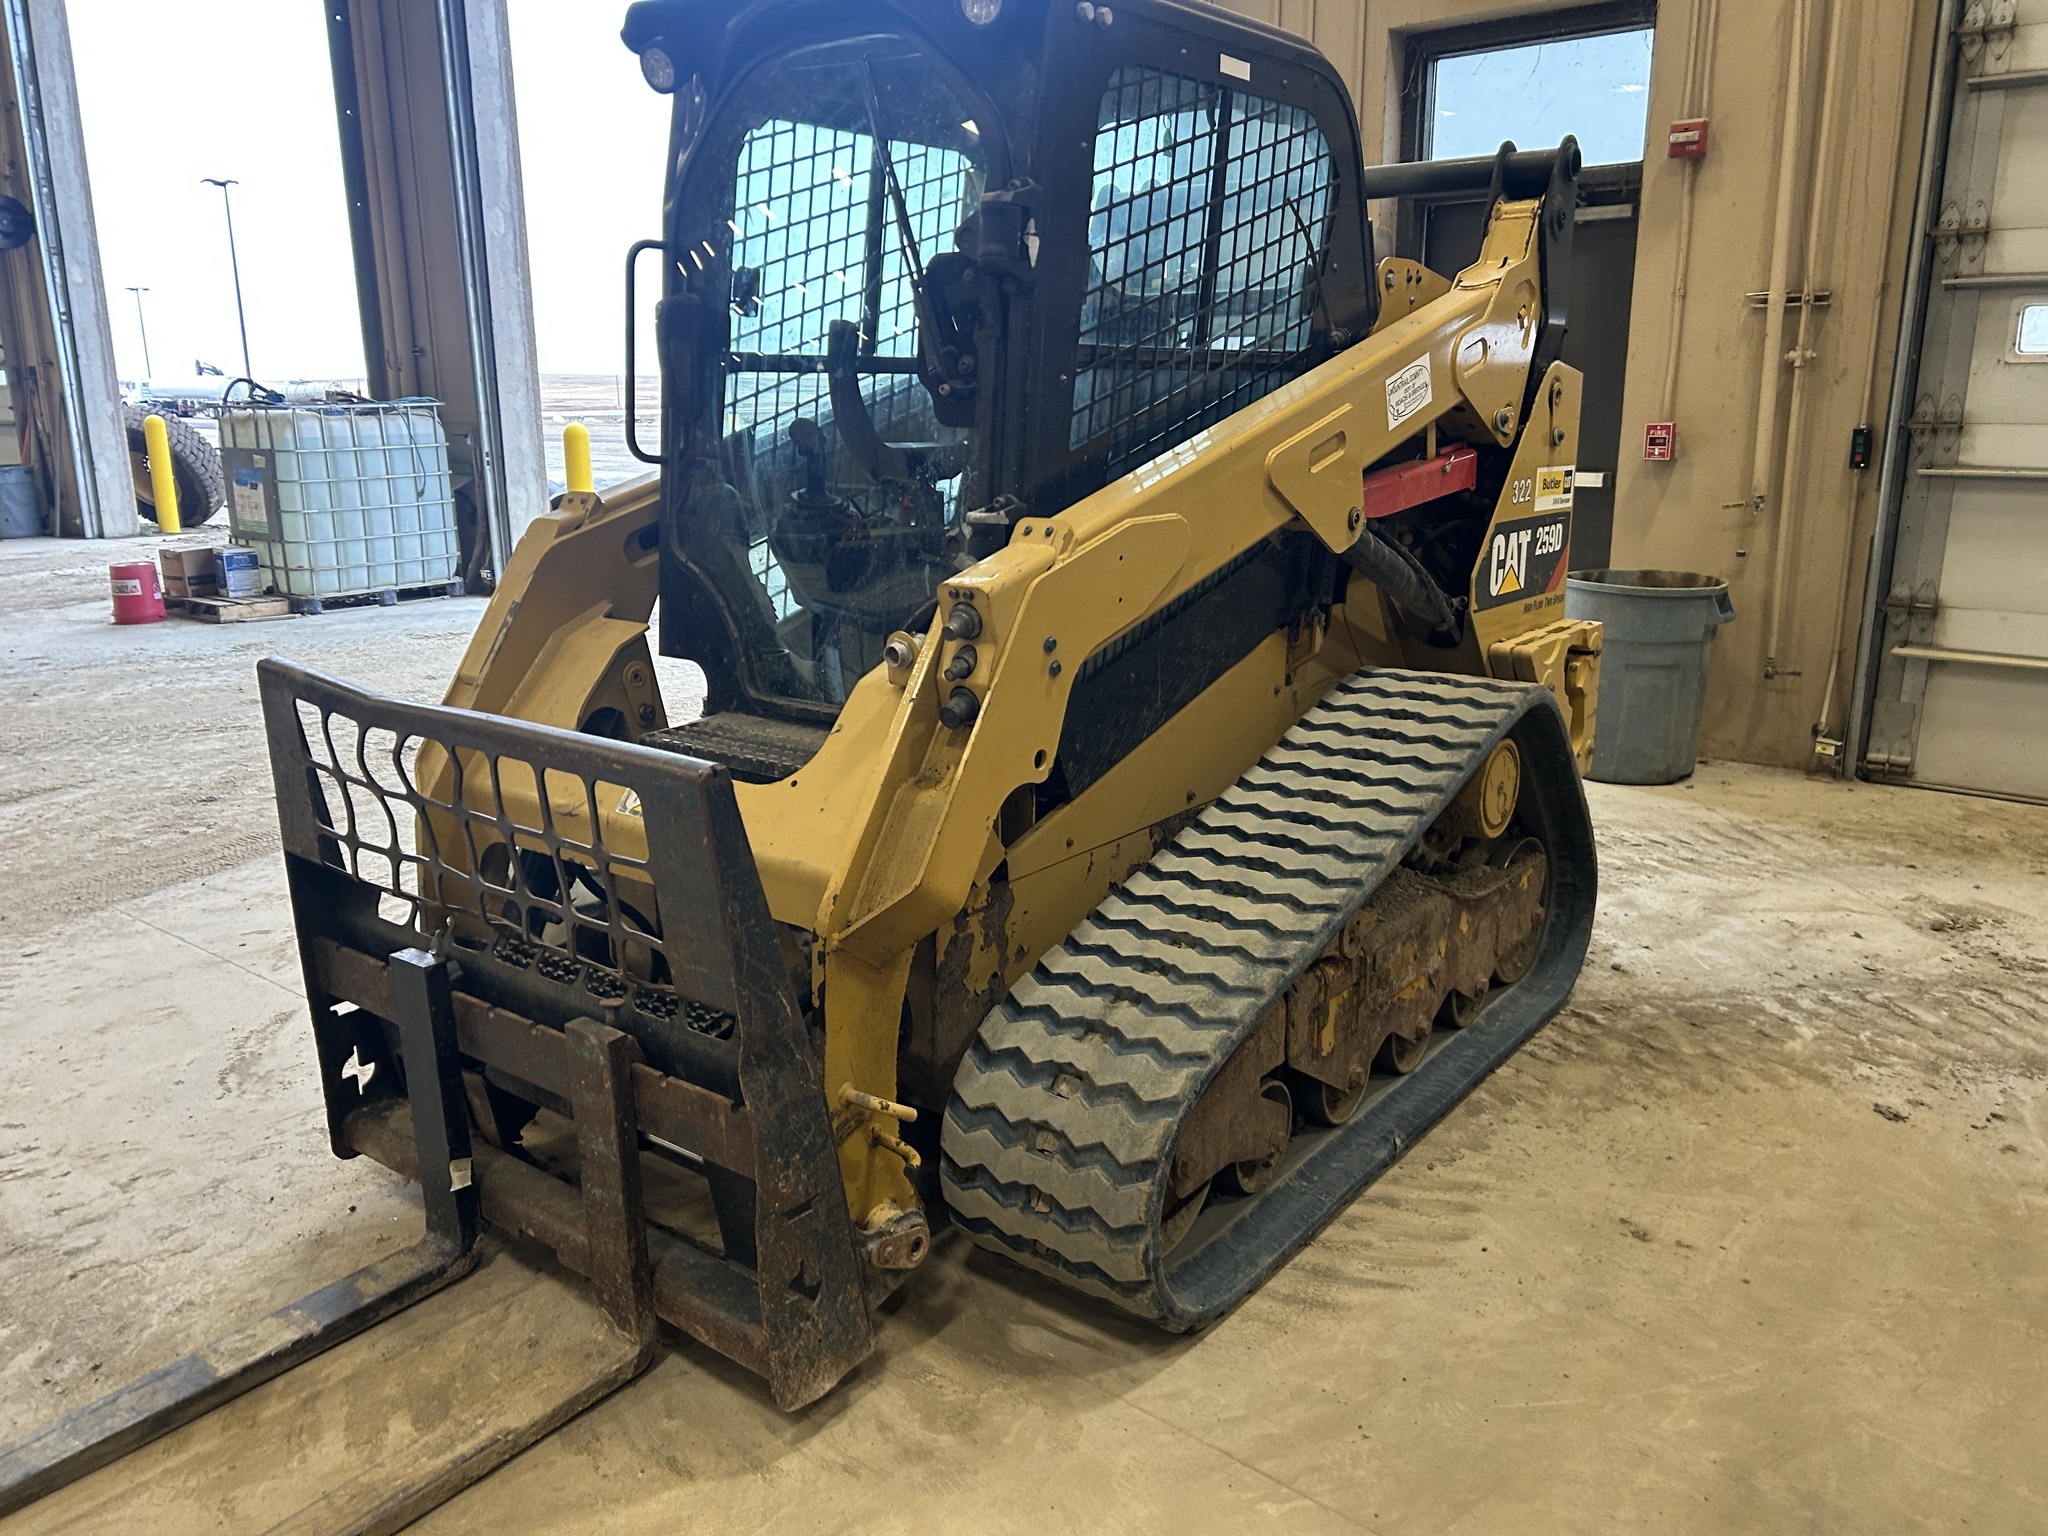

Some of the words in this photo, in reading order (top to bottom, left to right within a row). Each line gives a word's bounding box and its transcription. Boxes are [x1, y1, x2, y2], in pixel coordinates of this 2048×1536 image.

[1395, 394, 1408, 407] ROADS
[1512, 478, 1531, 504] 322
[1543, 477, 1561, 490] Butler
[1535, 523, 1563, 556] 259D
[1490, 530, 1532, 597] CAT
